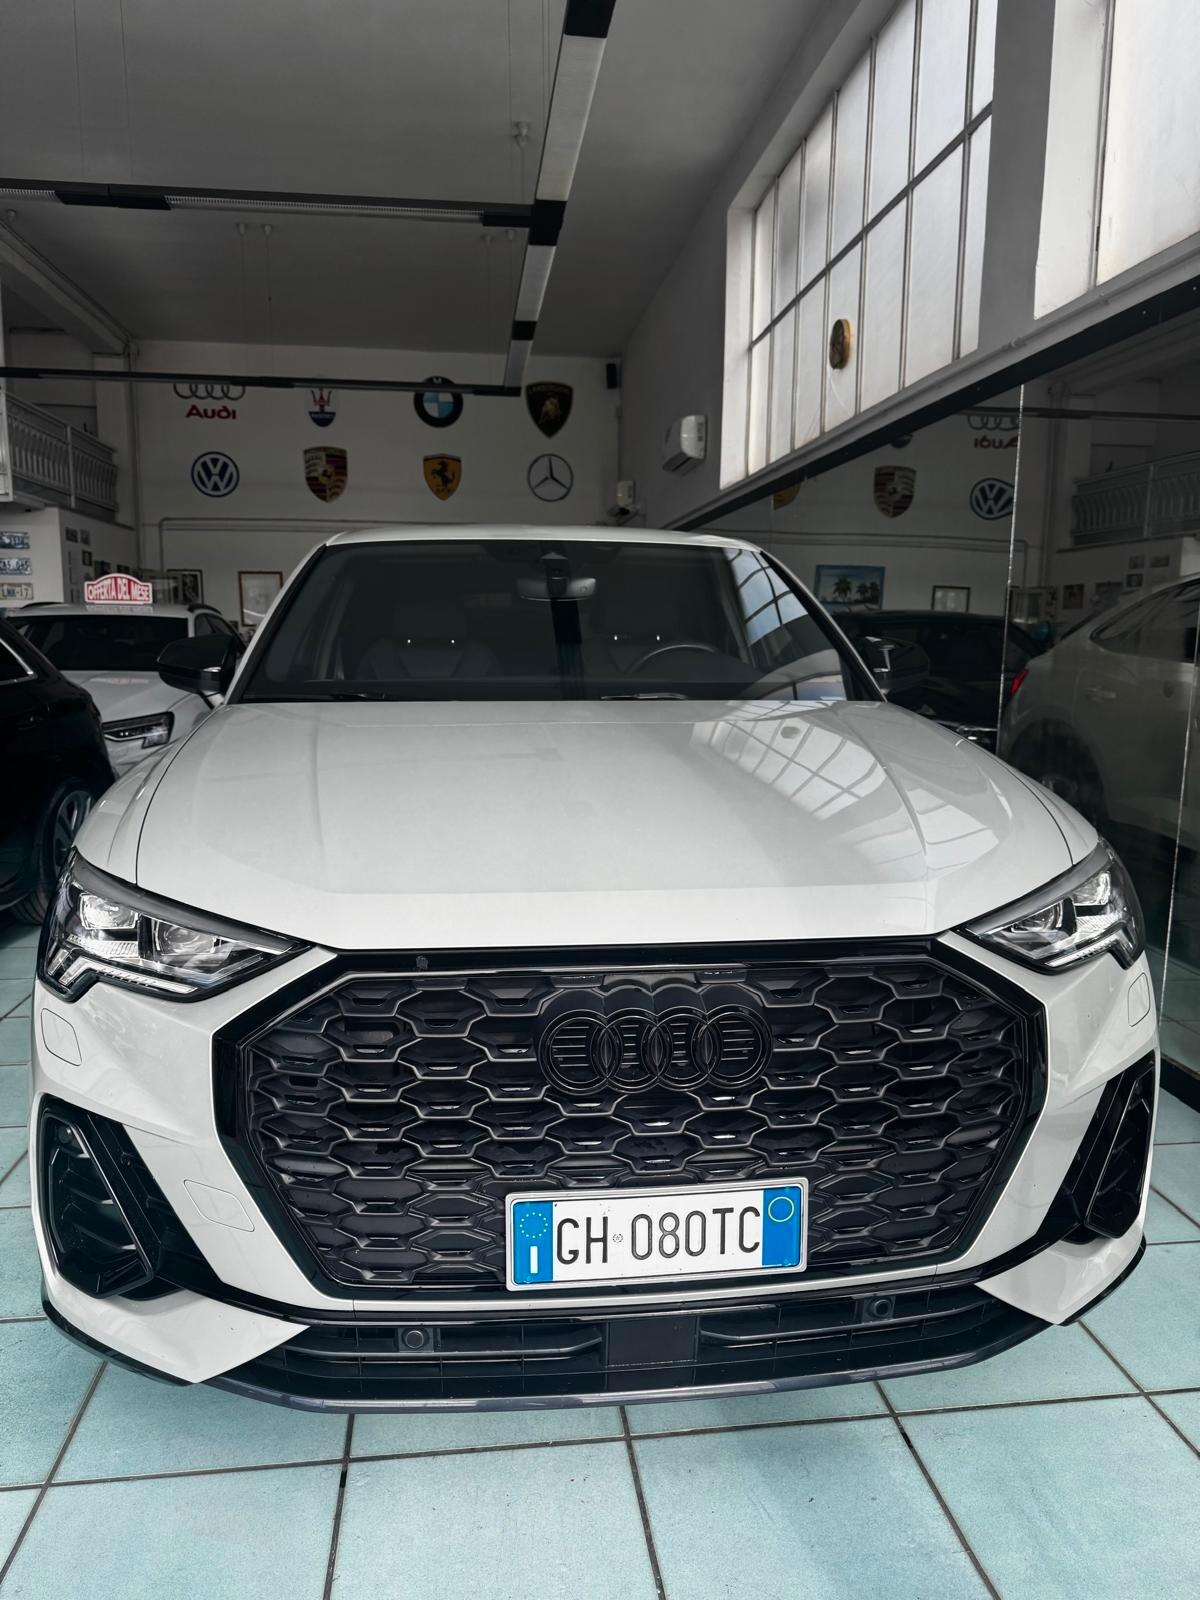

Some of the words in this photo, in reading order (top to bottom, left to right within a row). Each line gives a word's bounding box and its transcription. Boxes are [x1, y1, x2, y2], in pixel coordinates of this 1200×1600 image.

[185, 404, 237, 420] Audi
[88, 578, 116, 600] OFFERTA
[117, 578, 129, 600] DEL
[131, 580, 149, 600] MESE
[556, 1215, 609, 1265] GH
[630, 1206, 761, 1260] 080TC
